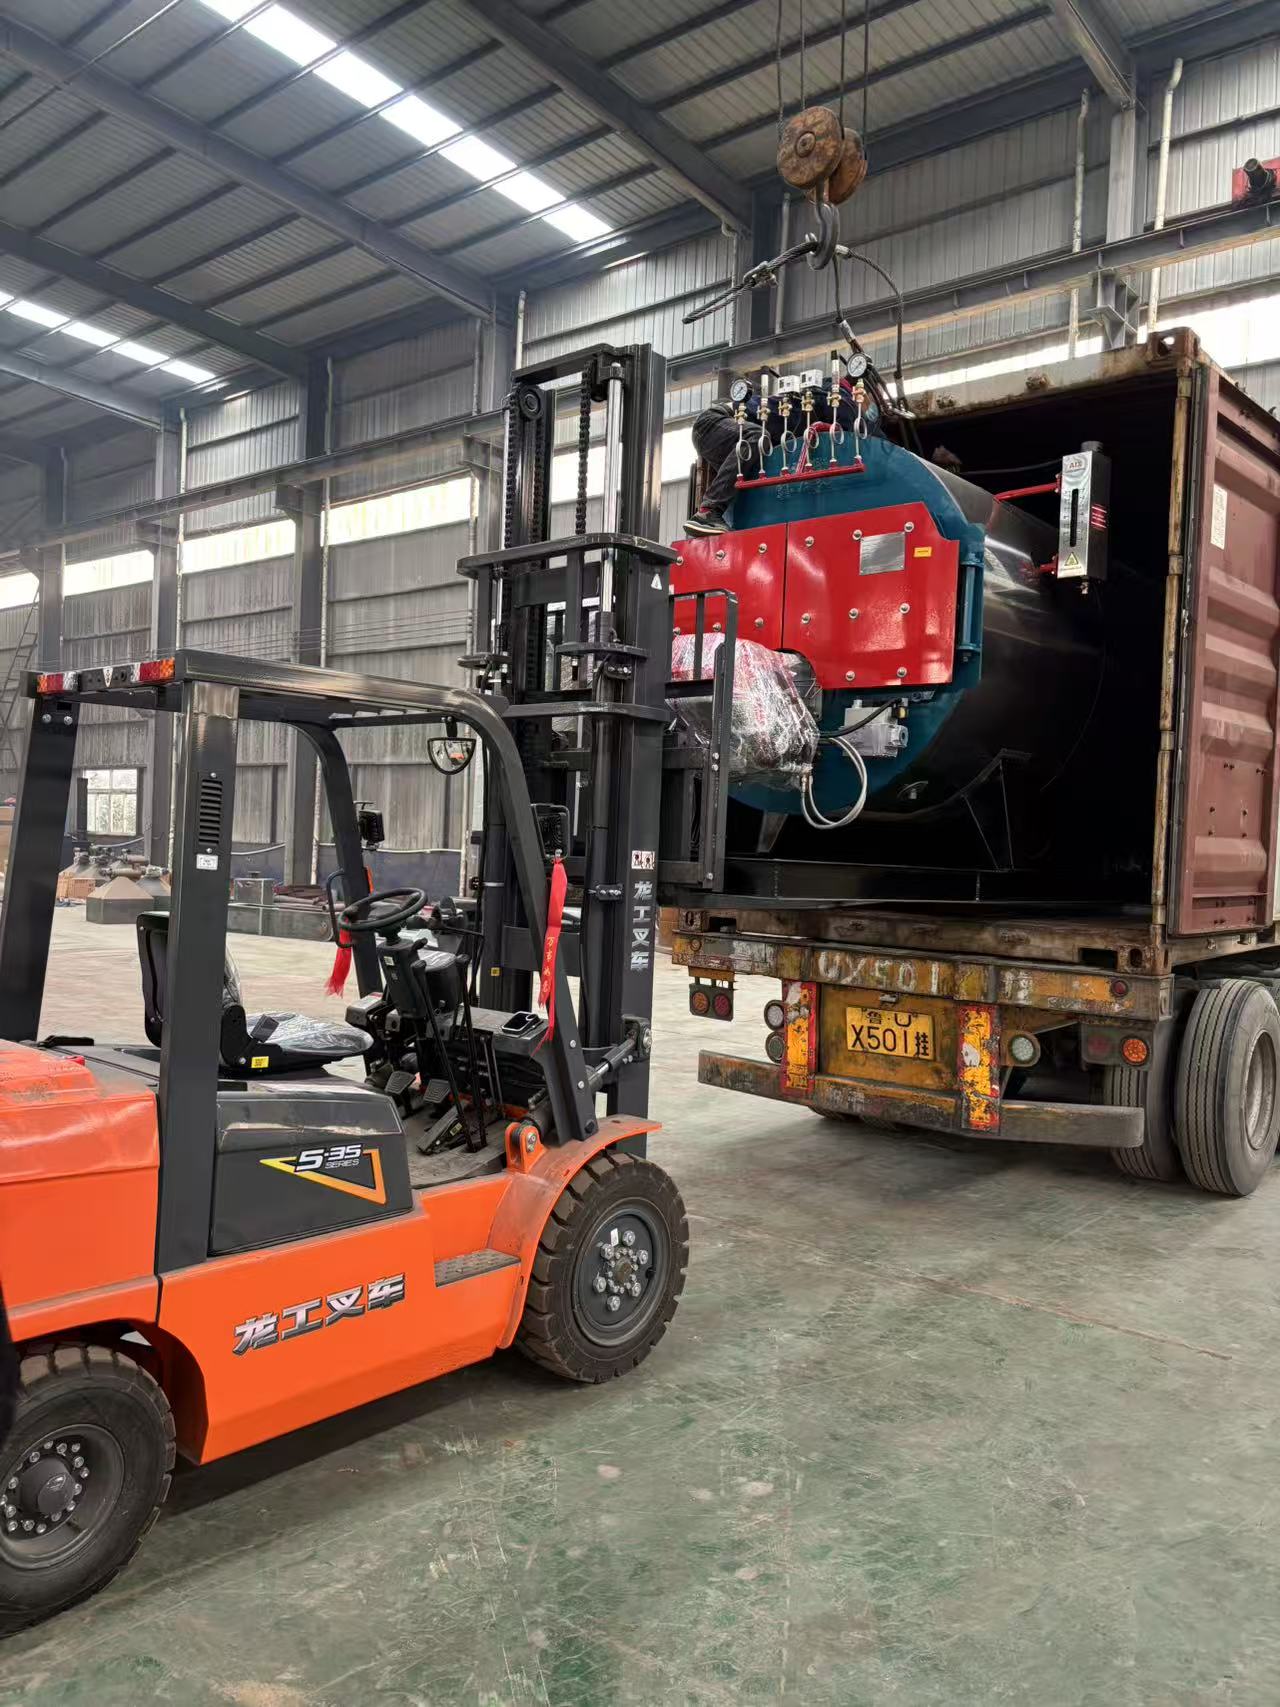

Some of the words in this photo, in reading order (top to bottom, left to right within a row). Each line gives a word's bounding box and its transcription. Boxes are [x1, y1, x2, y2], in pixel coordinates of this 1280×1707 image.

[630, 881, 653, 971] 龙工叉车
[851, 1024, 930, 1058] X501挂
[325, 1159, 360, 1169] SERIES
[232, 1272, 405, 1355] 龙工叉车
